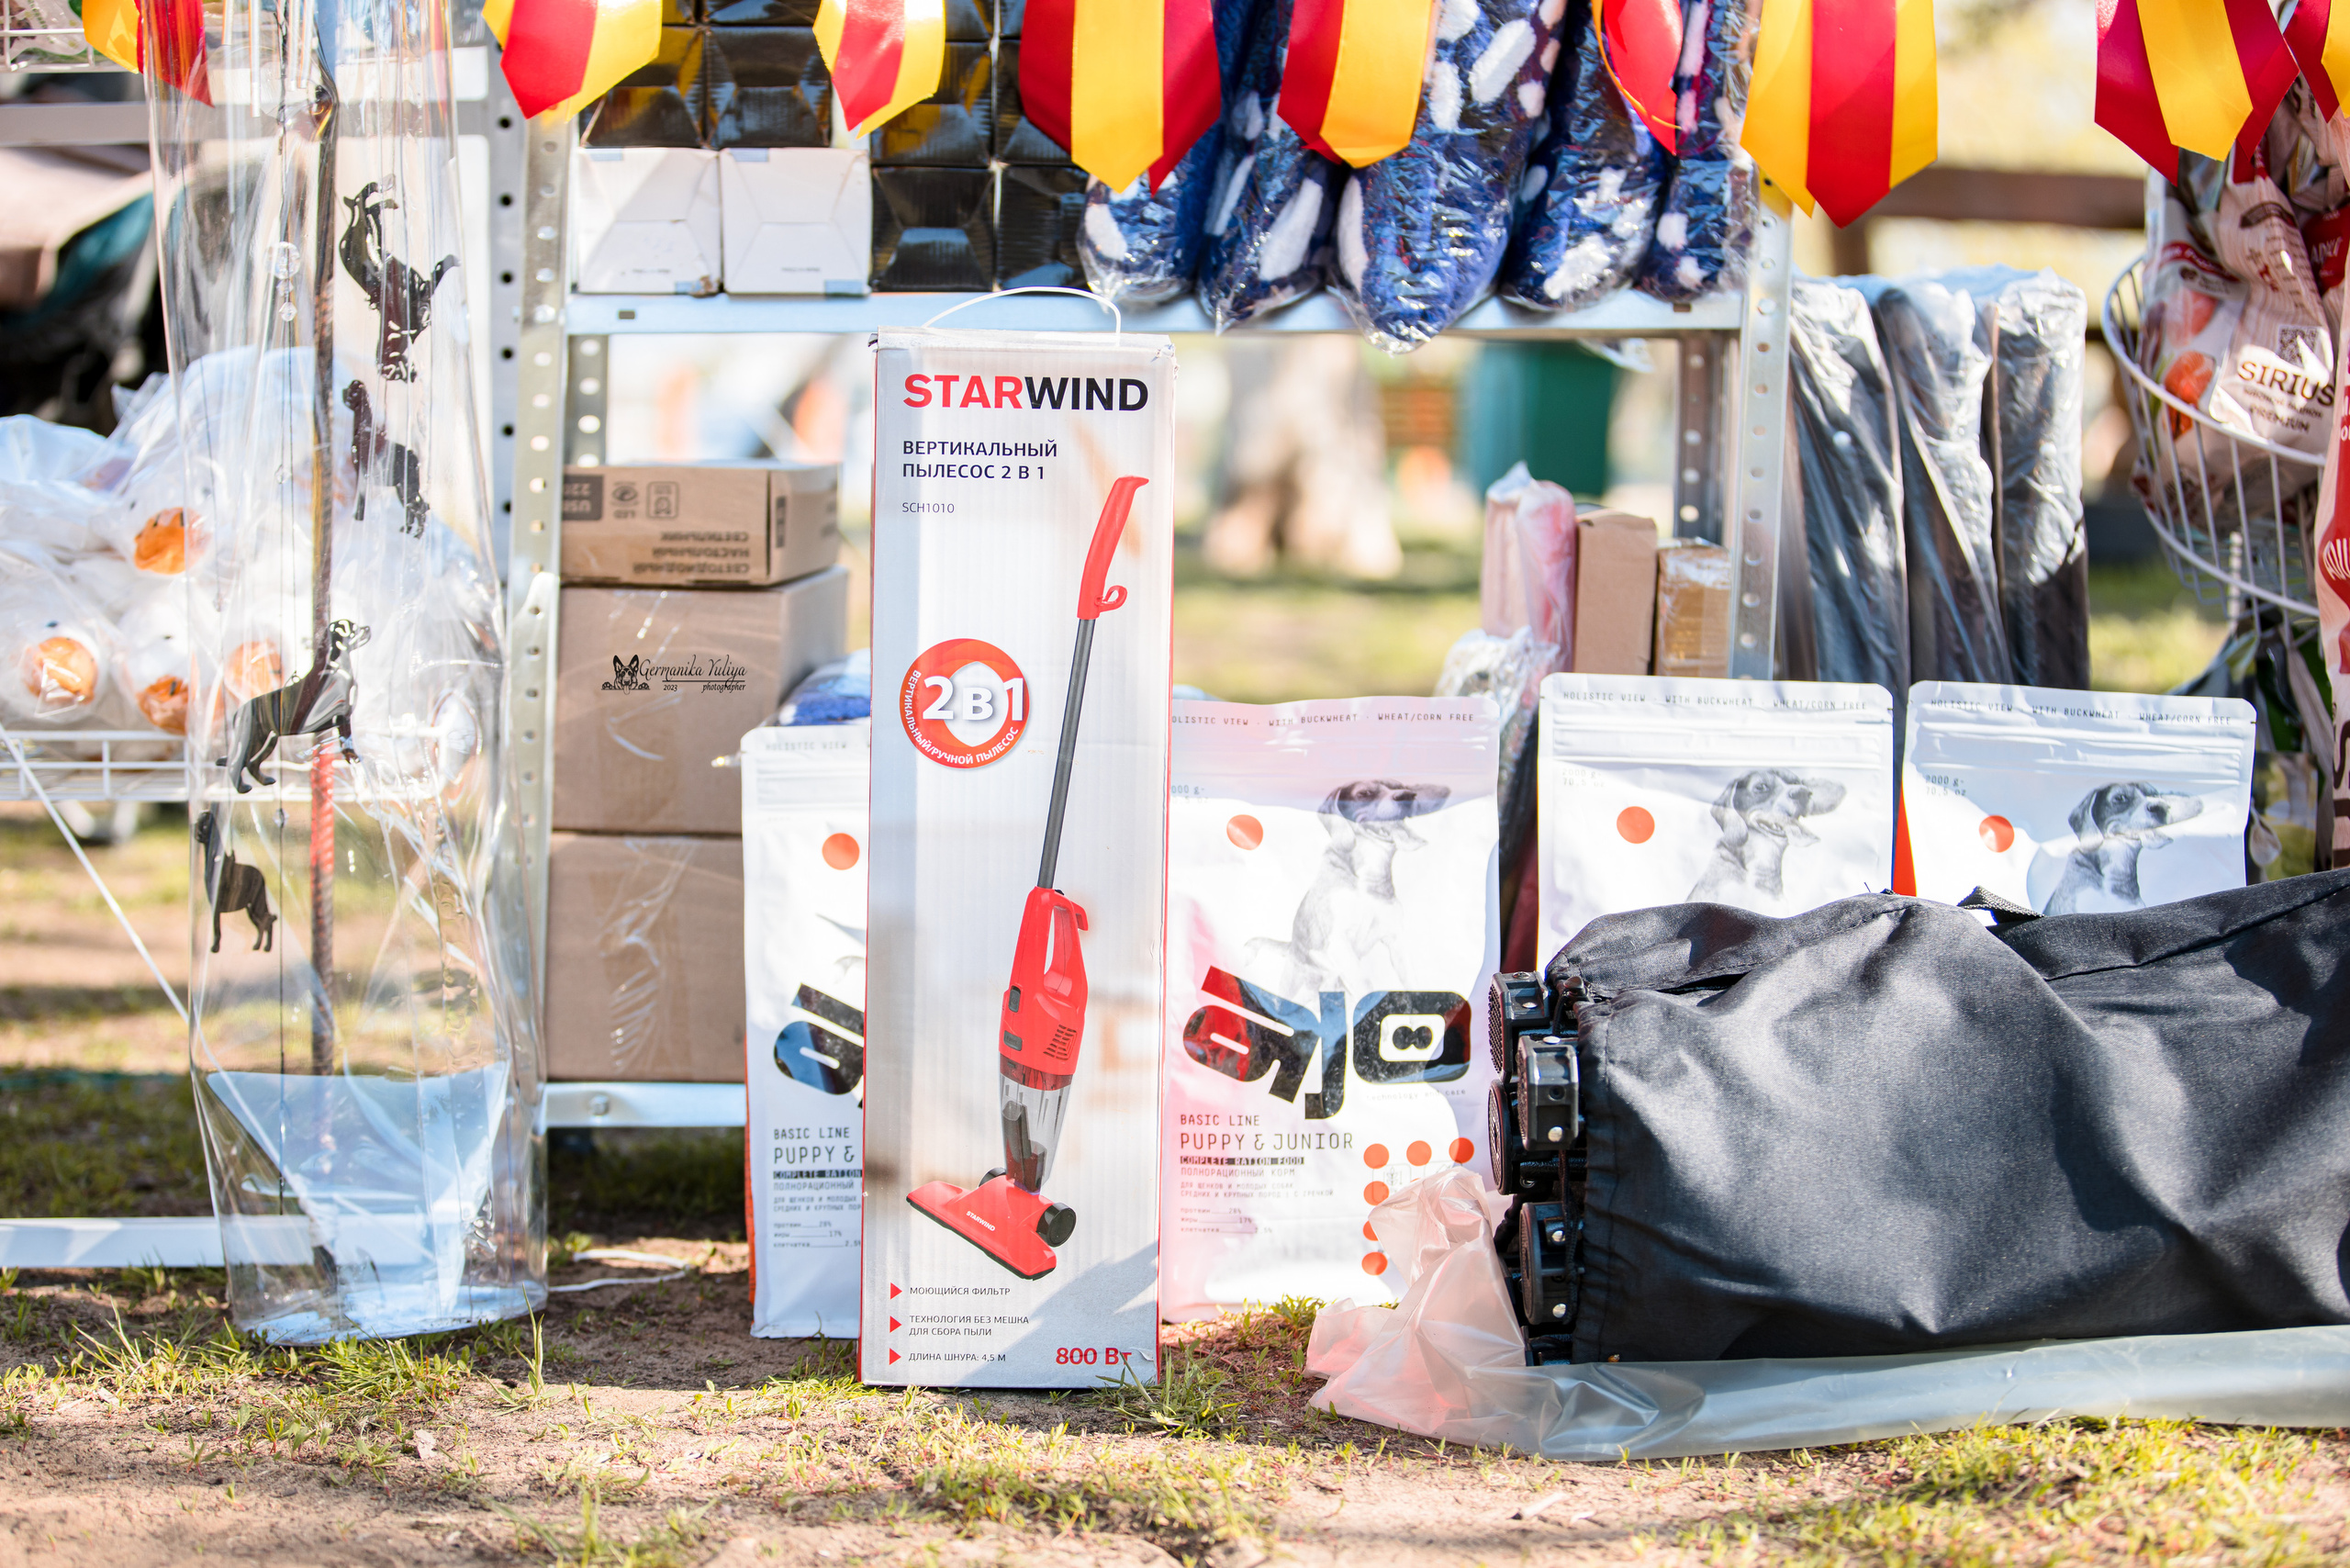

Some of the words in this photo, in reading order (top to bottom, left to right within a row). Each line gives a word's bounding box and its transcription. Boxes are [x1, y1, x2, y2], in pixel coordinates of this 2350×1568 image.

[2237, 361, 2335, 407] SIRIUS
[902, 373, 1148, 411] STARWIND
[903, 439, 1058, 457] ВЕРТИКАЛЬНЫЙ
[902, 464, 995, 478] ПЫЛЕСОС
[1002, 465, 1012, 479] 2
[1018, 466, 1030, 479] В
[1037, 466, 1045, 479] 1
[901, 502, 955, 514] SCH1010
[661, 532, 749, 543] СВЕТИЛЬНИК
[653, 547, 749, 559] НАСТОЛЬНЫЙ
[632, 563, 749, 575] СВЕТОДИОДНЫЙ
[1563, 691, 1614, 701] HOLISTIC
[1621, 693, 1646, 702] VIEW
[1665, 695, 1690, 704] WITH
[1697, 697, 1753, 707] BUCKWHEAT
[1773, 699, 1836, 711] WHEAT/CORN
[1842, 701, 1867, 711] FREE
[1171, 715, 1216, 724] OLISTIC
[1224, 718, 1248, 726] VIEW
[1269, 719, 1293, 727] WITH
[1301, 713, 1358, 723] BUCKWHEAT
[1378, 712, 1442, 722] WHEAT/CORN
[1449, 713, 1474, 722] FREE
[1987, 703, 2013, 712] VIEW
[2032, 706, 2057, 715] WITH
[2064, 707, 2120, 719] BUCKWHEAT
[2139, 712, 2201, 724] WHEAT/CORN
[2208, 715, 2232, 725] FREE
[822, 741, 847, 749] VIEW
[976, 726, 1019, 763] ПЫЛЕСОС
[1171, 785, 1189, 794] 000
[1181, 1114, 1219, 1126] BASIC
[1229, 1114, 1260, 1126] LINE
[774, 1128, 811, 1140] BASIC
[820, 1127, 850, 1138] LINE
[1181, 1133, 1245, 1150] PUPPY
[1254, 1134, 1265, 1150] &
[1273, 1132, 1354, 1150] JUNIOR
[774, 1146, 835, 1164] PUPPY
[844, 1146, 855, 1162] &
[1181, 1156, 1229, 1165] COMPLETE
[1235, 1157, 1271, 1165] RATION
[1278, 1157, 1304, 1165] FOOD
[774, 1170, 819, 1180] COMPLETE
[1181, 1167, 1265, 1178] ПОЛНОРАЦИОННЫЙ
[1271, 1168, 1295, 1177] КОРМ
[774, 1180, 854, 1191] ПОЛНОРАЦИОННЫЙ
[1181, 1190, 1210, 1198] СРЕДНИХ
[774, 1204, 801, 1213] СРЕДНИХ
[966, 1210, 996, 1232] STARWIND
[910, 1285, 969, 1296] МОЮЩИЙСЯ
[971, 1287, 1011, 1296] ФИЛЬТР
[910, 1315, 971, 1324] ТЕХНОЛОГИЯ
[974, 1316, 991, 1324] БЕЗ
[994, 1316, 1029, 1324] МЕШКА
[909, 1327, 929, 1337] ДЛЯ
[931, 1327, 961, 1336] СБОРА
[964, 1327, 991, 1337] ПЫЛИ
[909, 1352, 942, 1362] ДЛИНА
[945, 1353, 979, 1362] ШНУРА:
[981, 1353, 995, 1363] 4,5
[1056, 1347, 1098, 1365] 800
